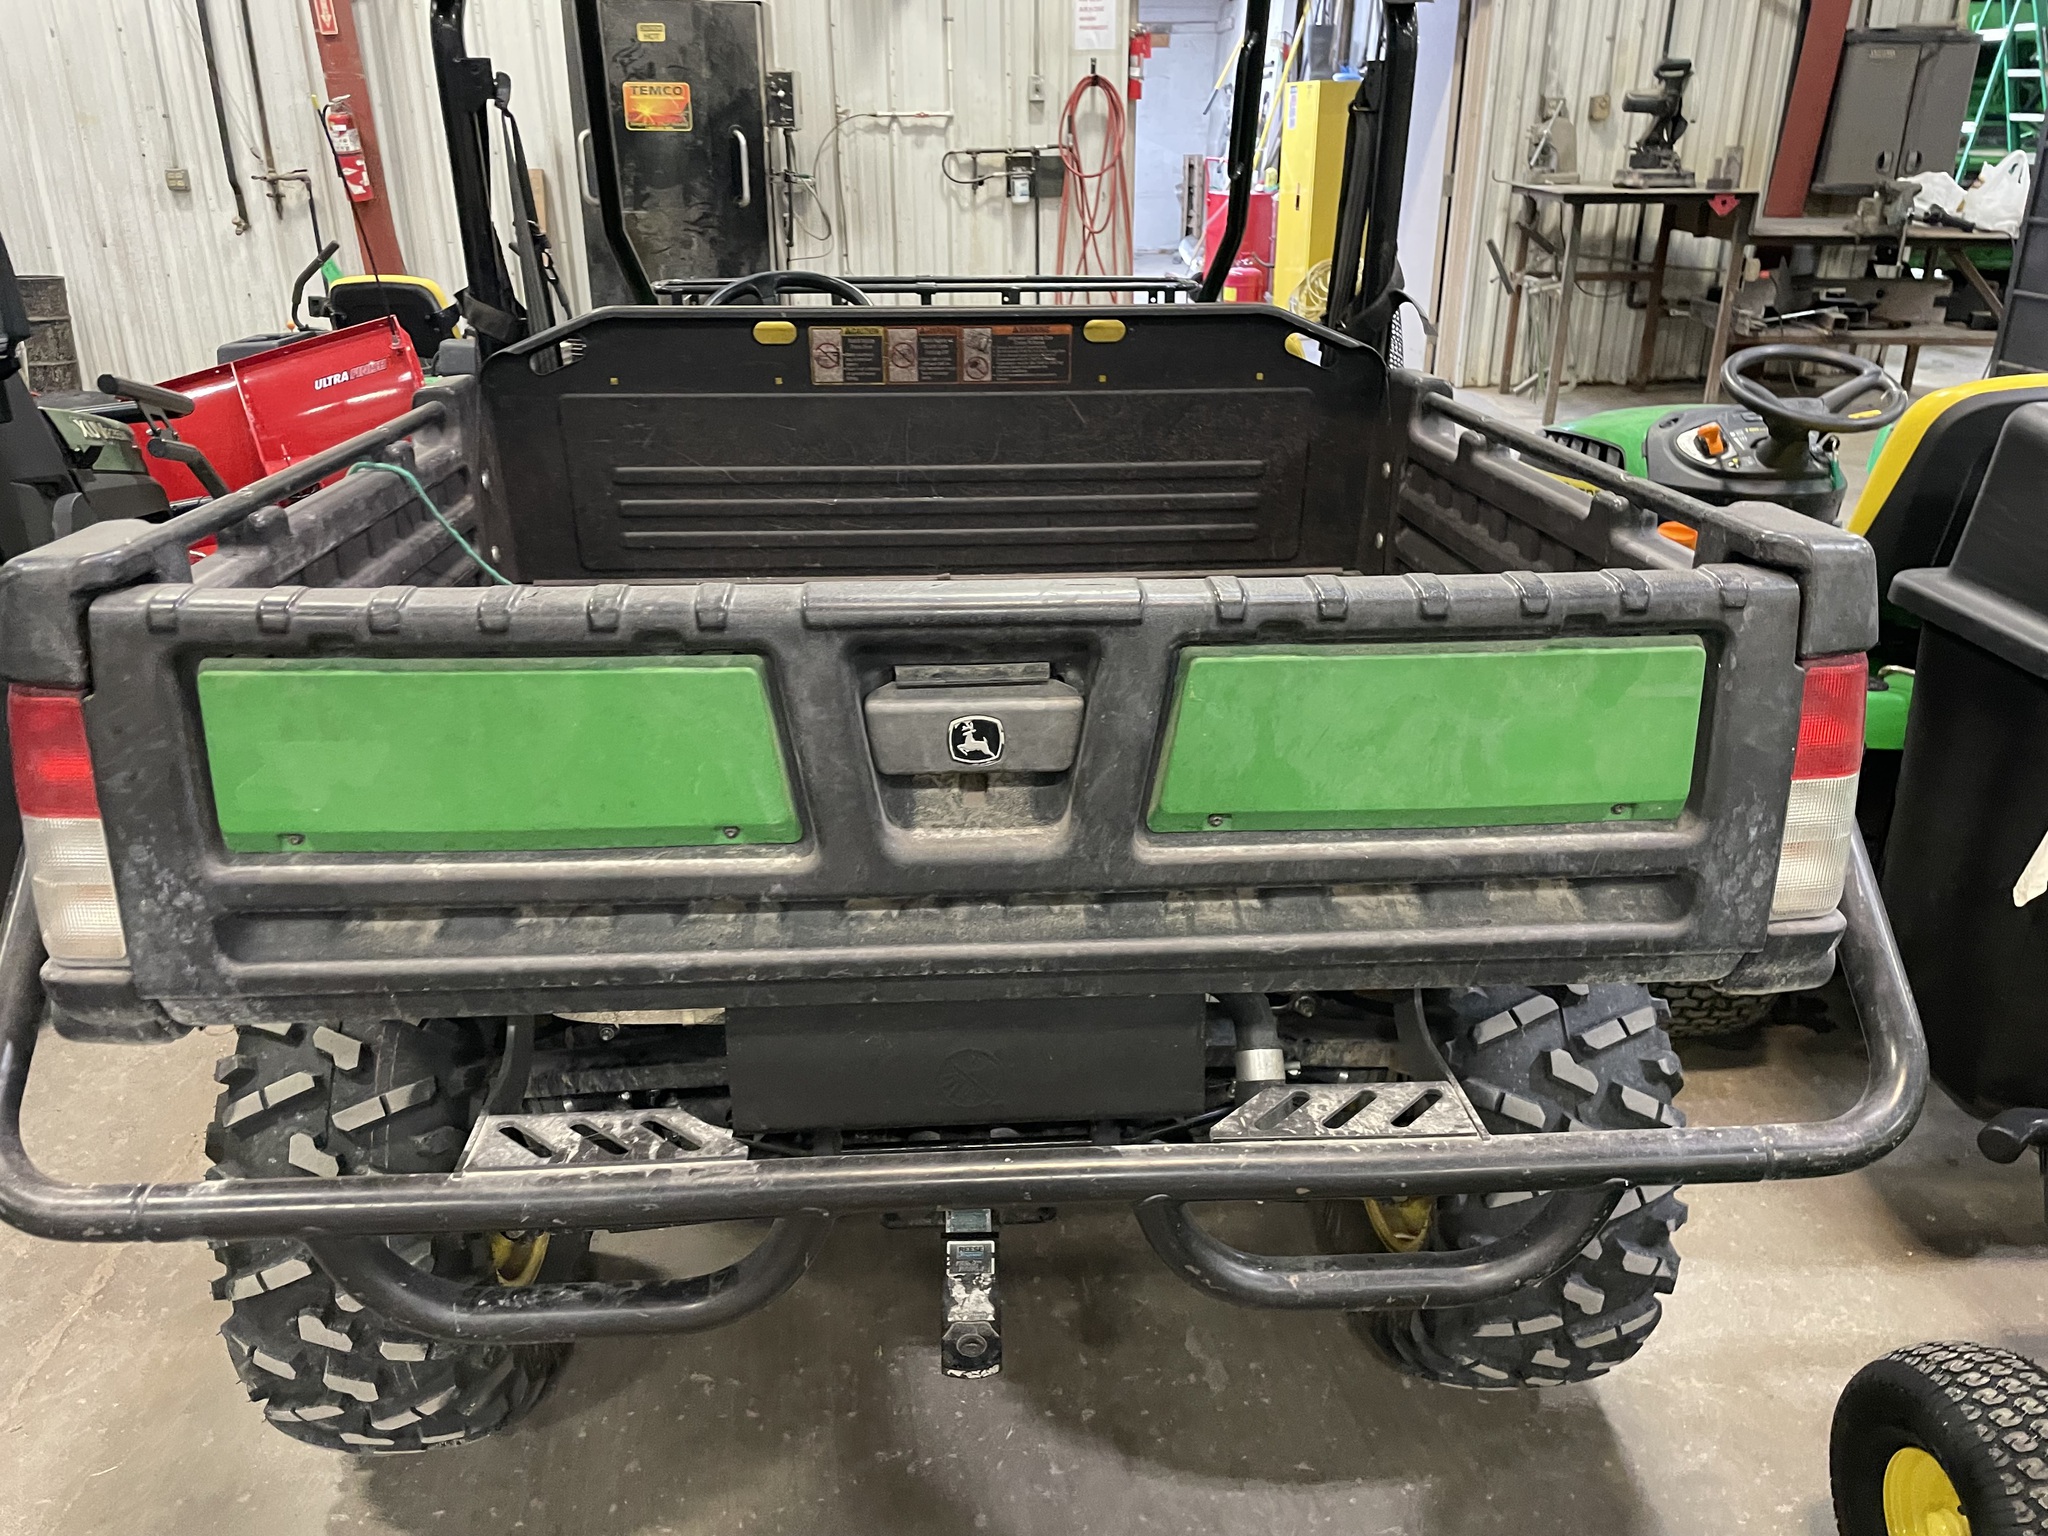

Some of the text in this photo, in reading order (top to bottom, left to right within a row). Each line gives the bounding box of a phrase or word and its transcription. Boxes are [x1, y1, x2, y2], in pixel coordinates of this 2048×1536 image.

[630, 86, 683, 96] TEMCO
[314, 371, 350, 391] ULTRA
[73, 419, 108, 438] XUV
